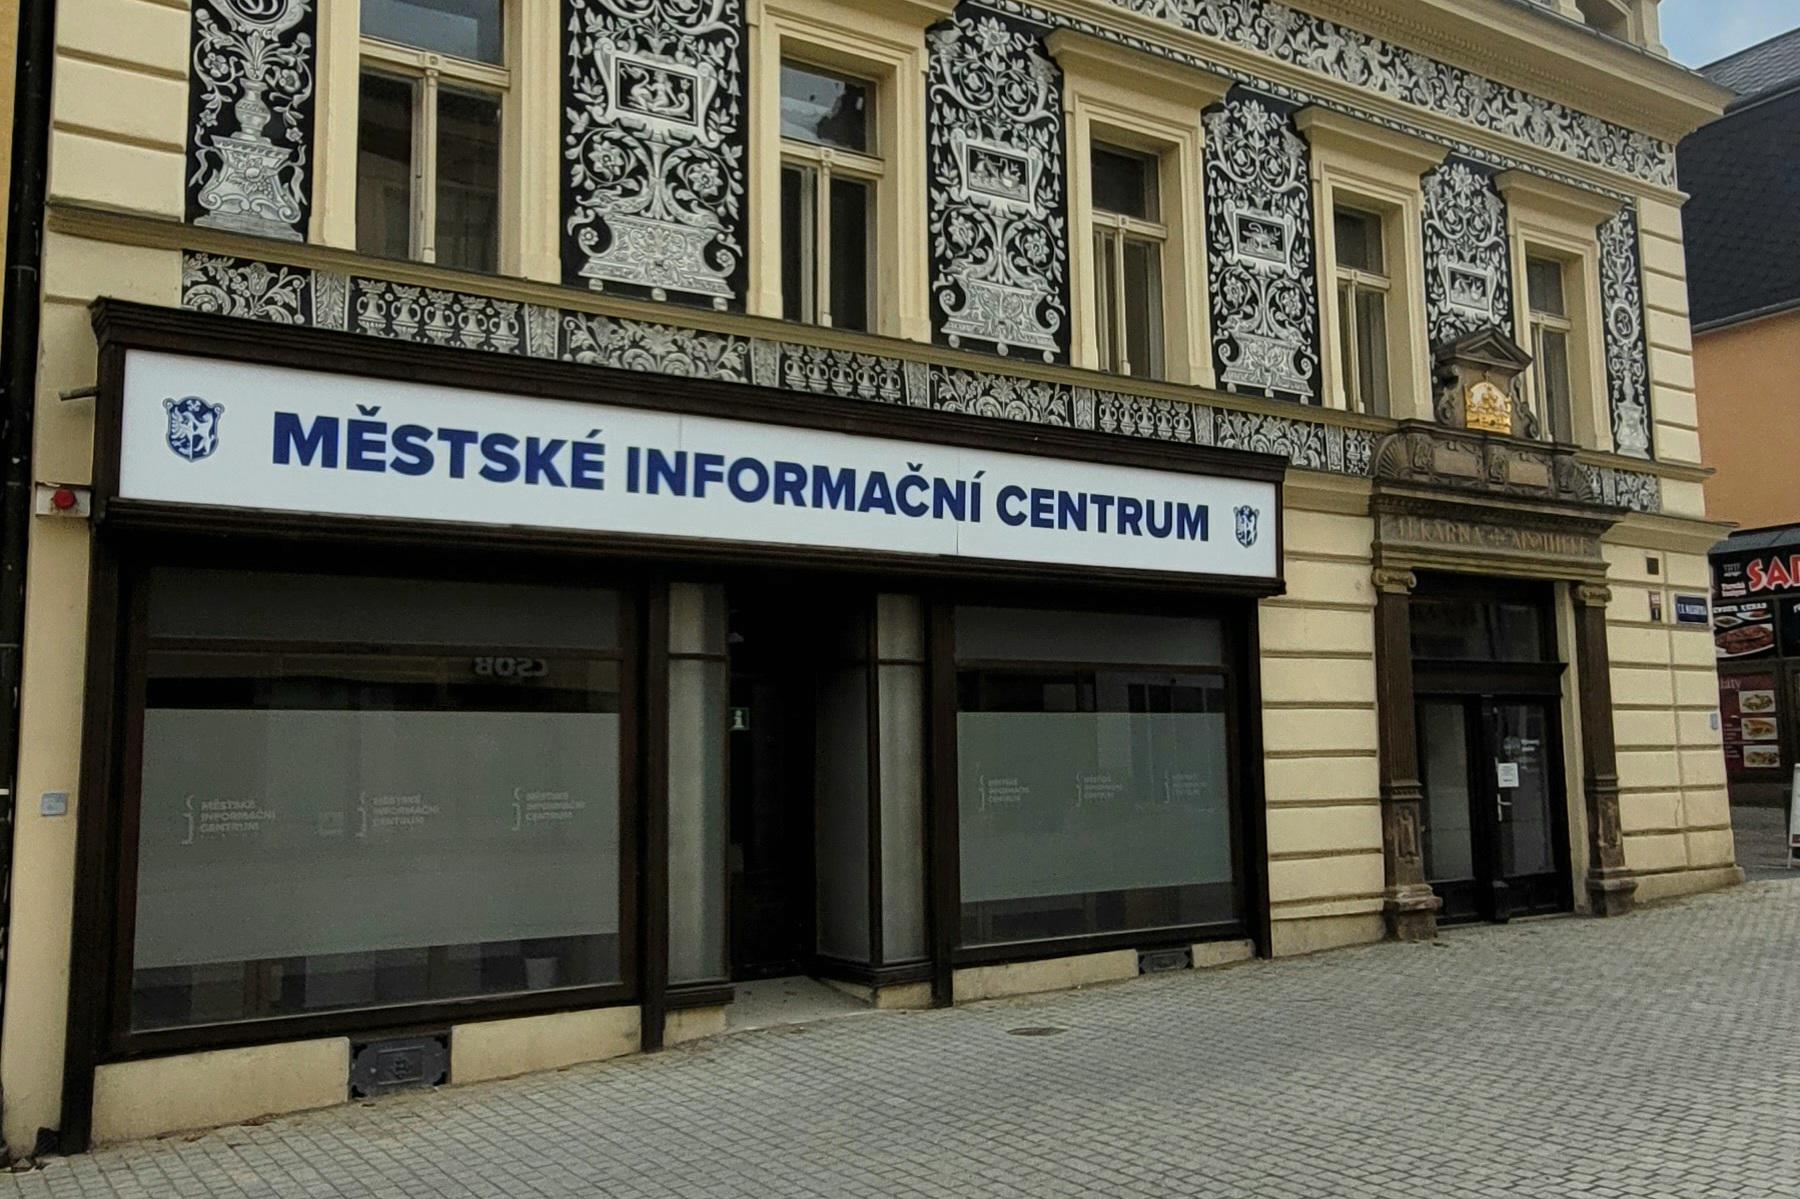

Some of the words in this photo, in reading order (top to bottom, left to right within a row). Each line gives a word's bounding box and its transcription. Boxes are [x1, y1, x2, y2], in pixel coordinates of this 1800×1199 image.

[273, 405, 604, 490] MĚSTSKÉ
[626, 447, 984, 523] INFORMAČNÍ
[996, 485, 1209, 542] CENTRUM
